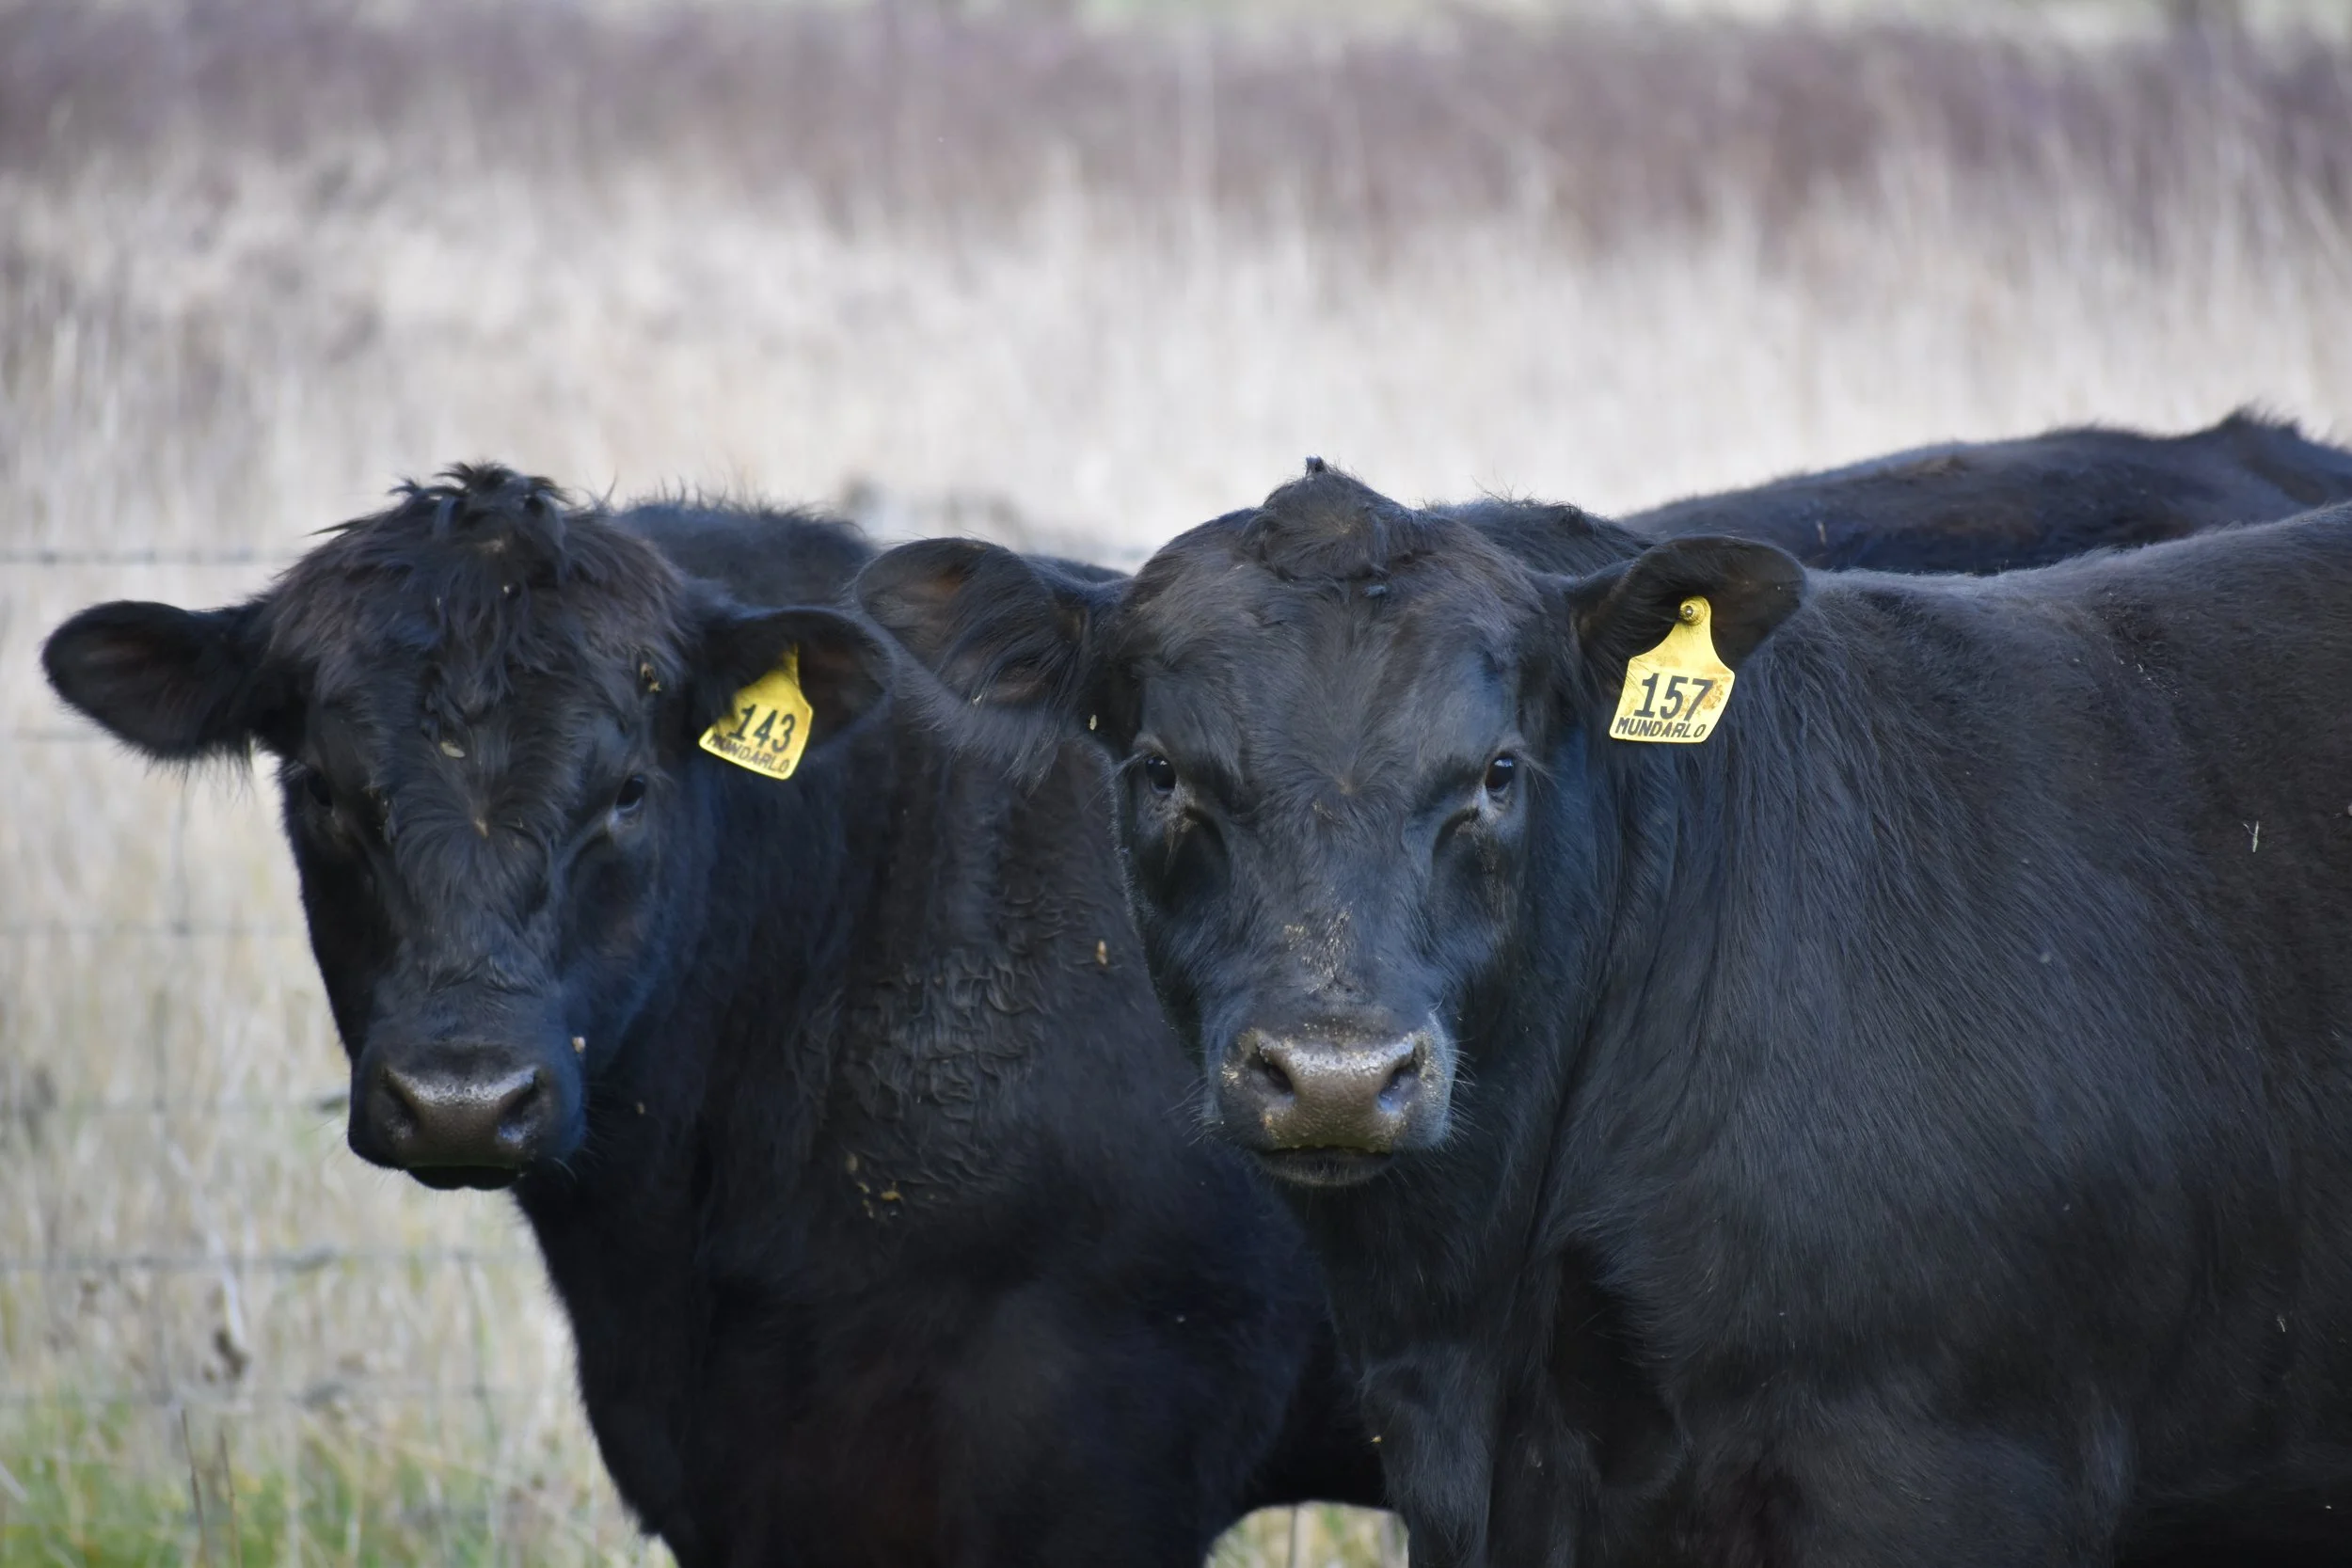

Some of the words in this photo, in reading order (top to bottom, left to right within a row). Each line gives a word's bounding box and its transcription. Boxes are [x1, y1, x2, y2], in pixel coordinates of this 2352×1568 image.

[1633, 673, 1715, 721] 157
[728, 704, 796, 753] 143
[1614, 717, 1708, 738] MUNDARLO
